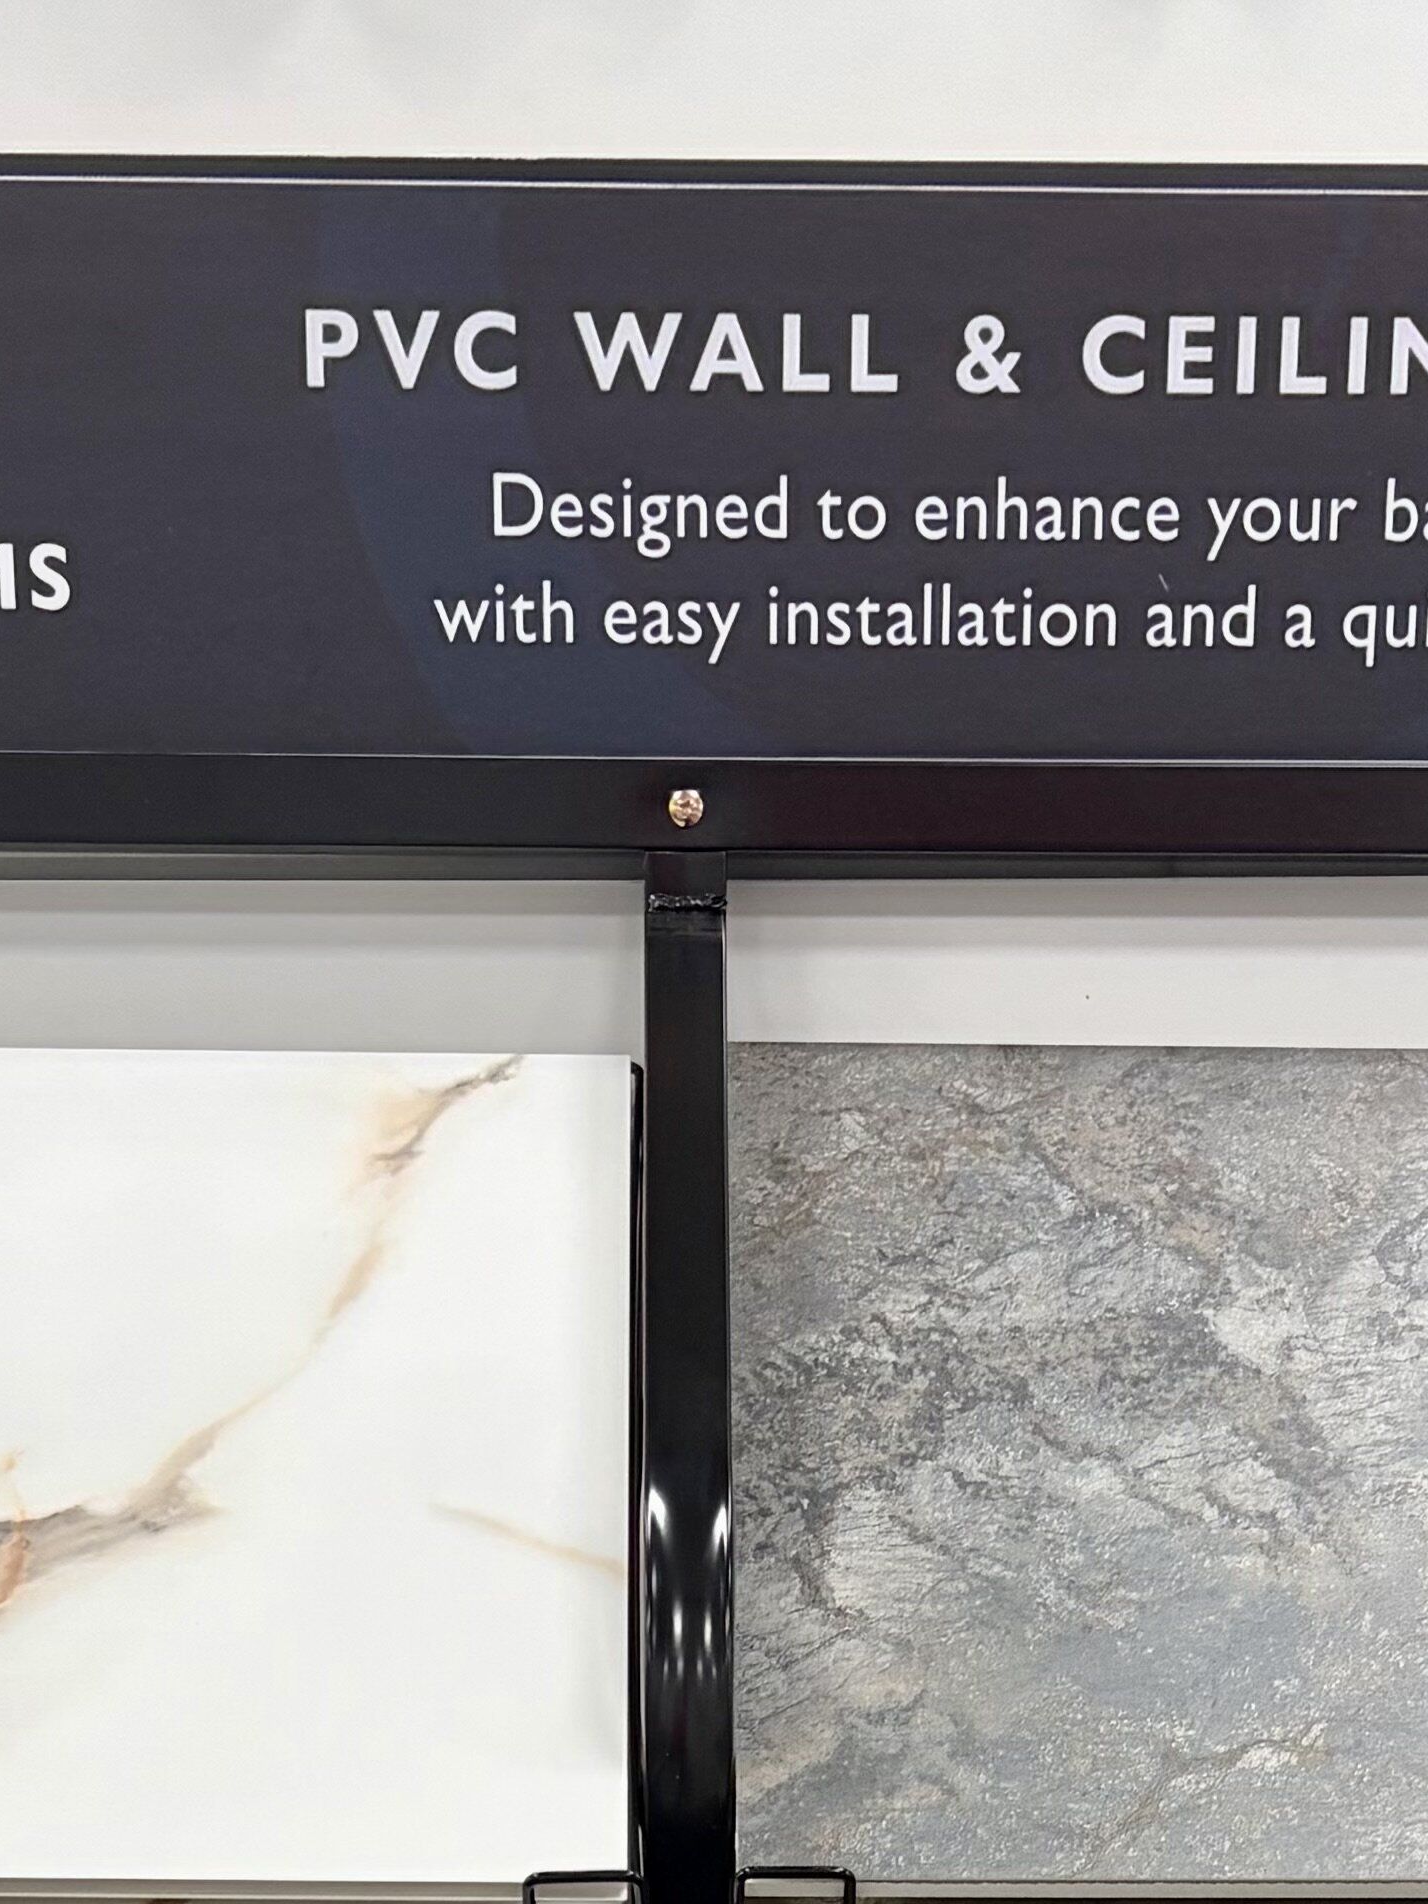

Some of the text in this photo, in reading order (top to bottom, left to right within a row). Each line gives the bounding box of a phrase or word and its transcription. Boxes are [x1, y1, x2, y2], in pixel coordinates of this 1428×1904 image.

[306, 309, 516, 389] PVC
[574, 312, 898, 392] WALL
[956, 315, 1020, 393] &
[493, 473, 787, 557] Designed
[817, 490, 886, 539] to
[916, 476, 1179, 541] enhance
[1208, 498, 1357, 561] your
[434, 580, 573, 643] with
[604, 601, 740, 664] easy
[769, 583, 1116, 646] installation
[1145, 586, 1255, 647] and
[1285, 604, 1315, 647] a
